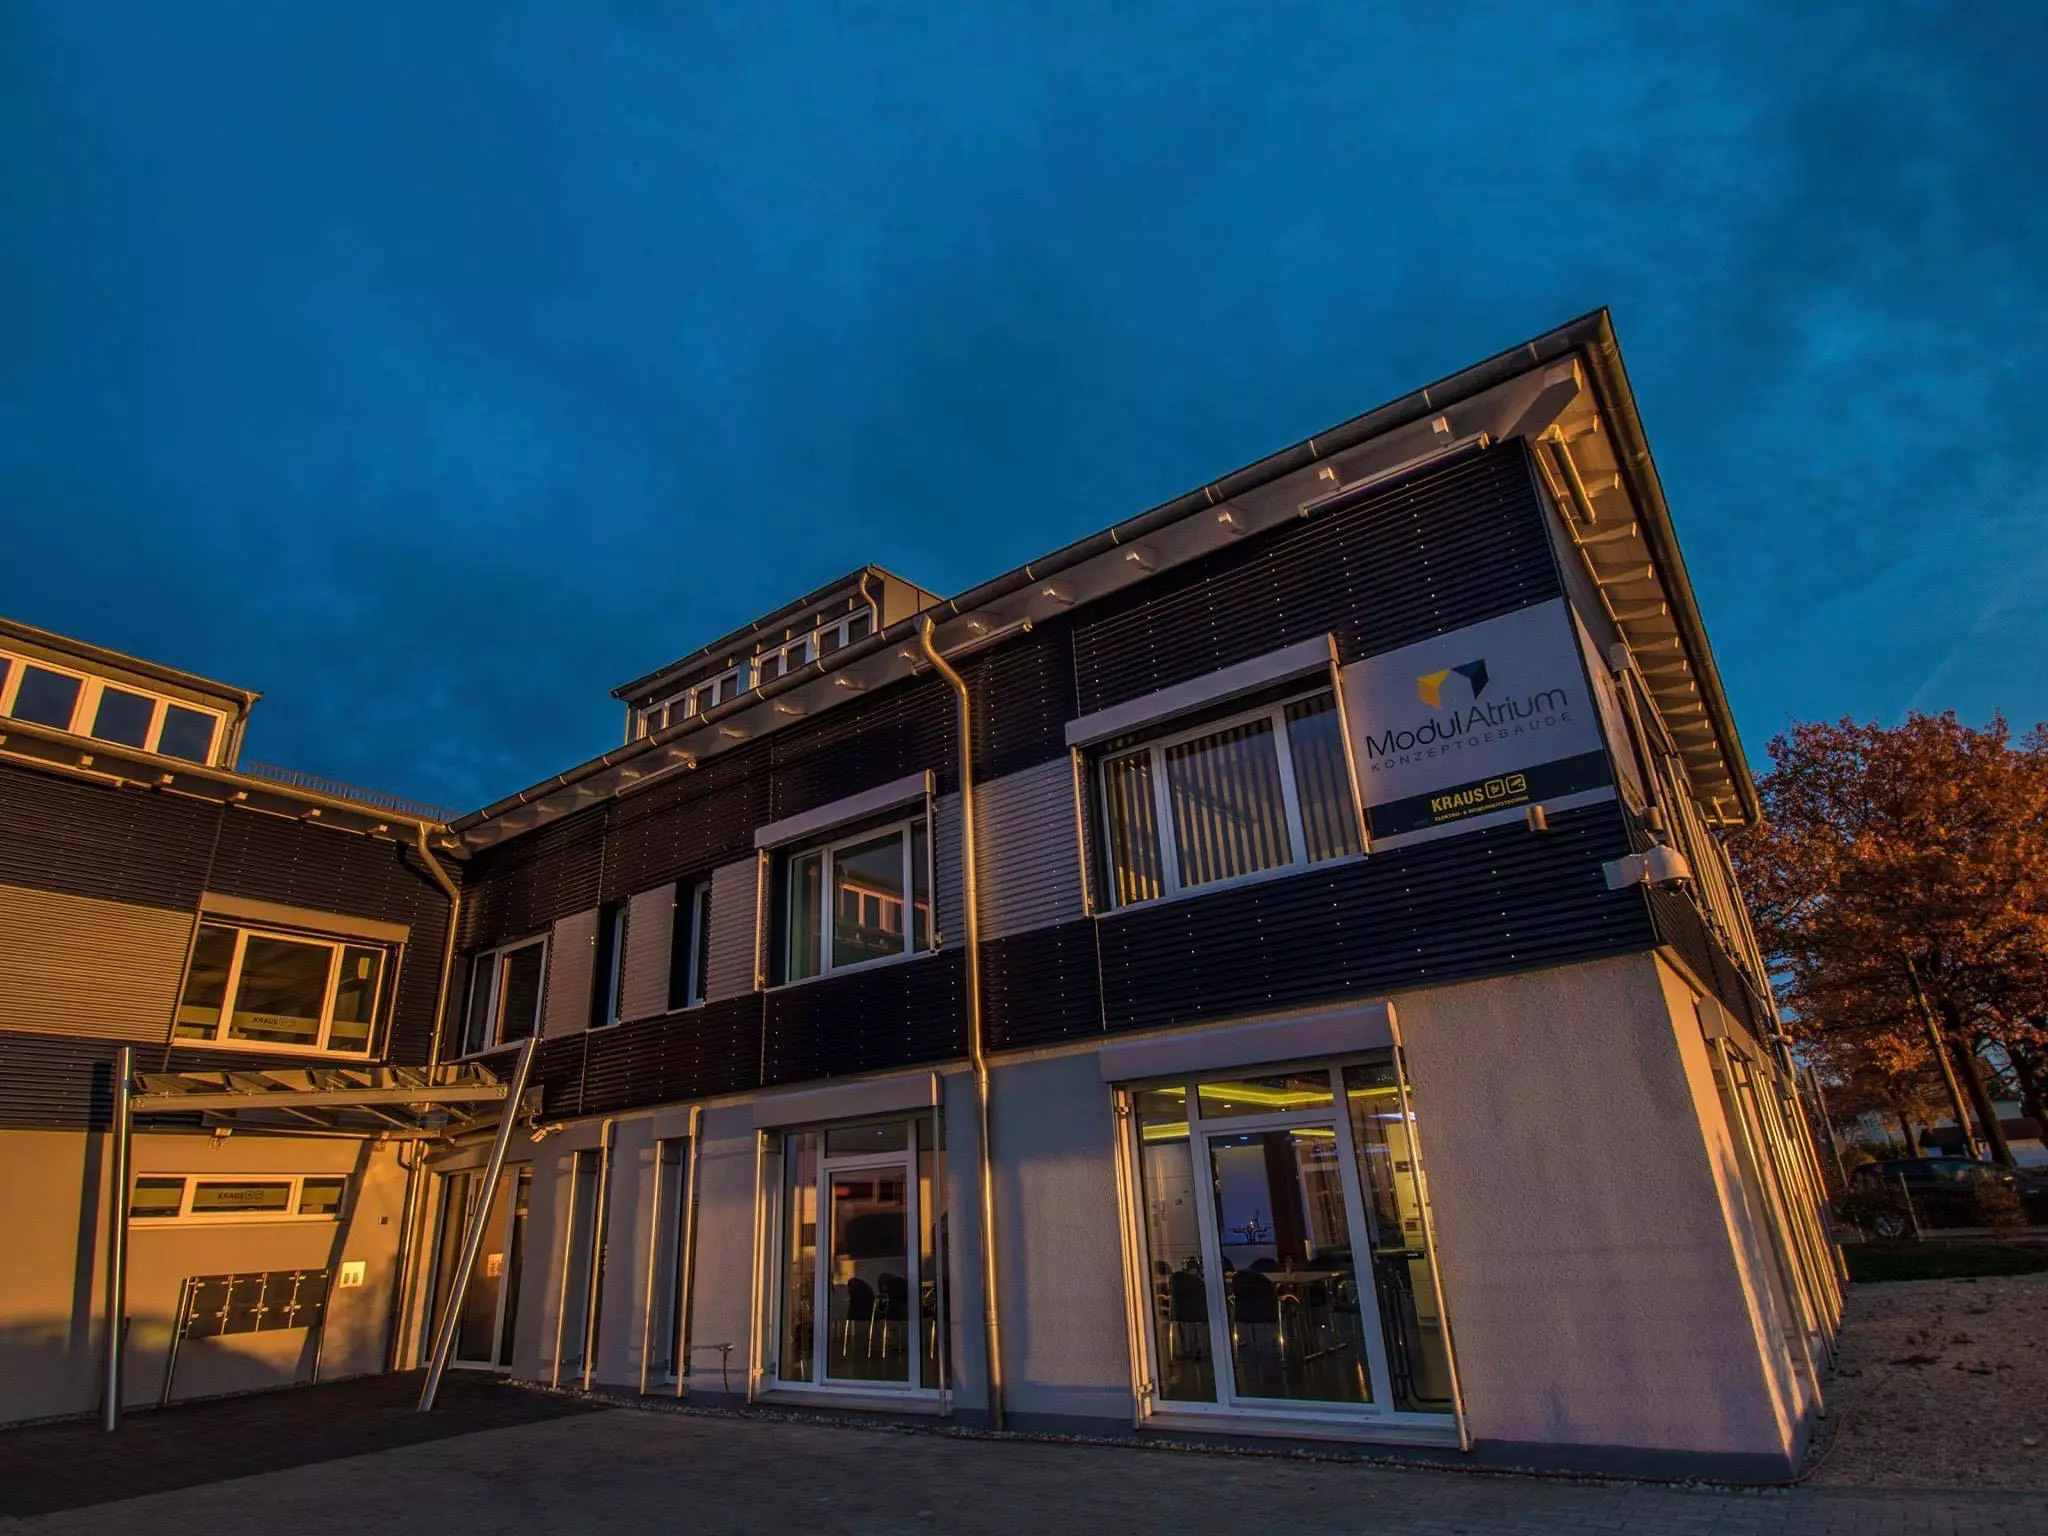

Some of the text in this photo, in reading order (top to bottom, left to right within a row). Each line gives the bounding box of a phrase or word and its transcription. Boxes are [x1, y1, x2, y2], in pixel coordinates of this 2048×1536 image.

[1366, 688, 1568, 759] ModulAtrium
[1431, 788, 1485, 813] KRAUS
[253, 1017, 278, 1025] KRAUS
[217, 1192, 244, 1200] KRAUS
